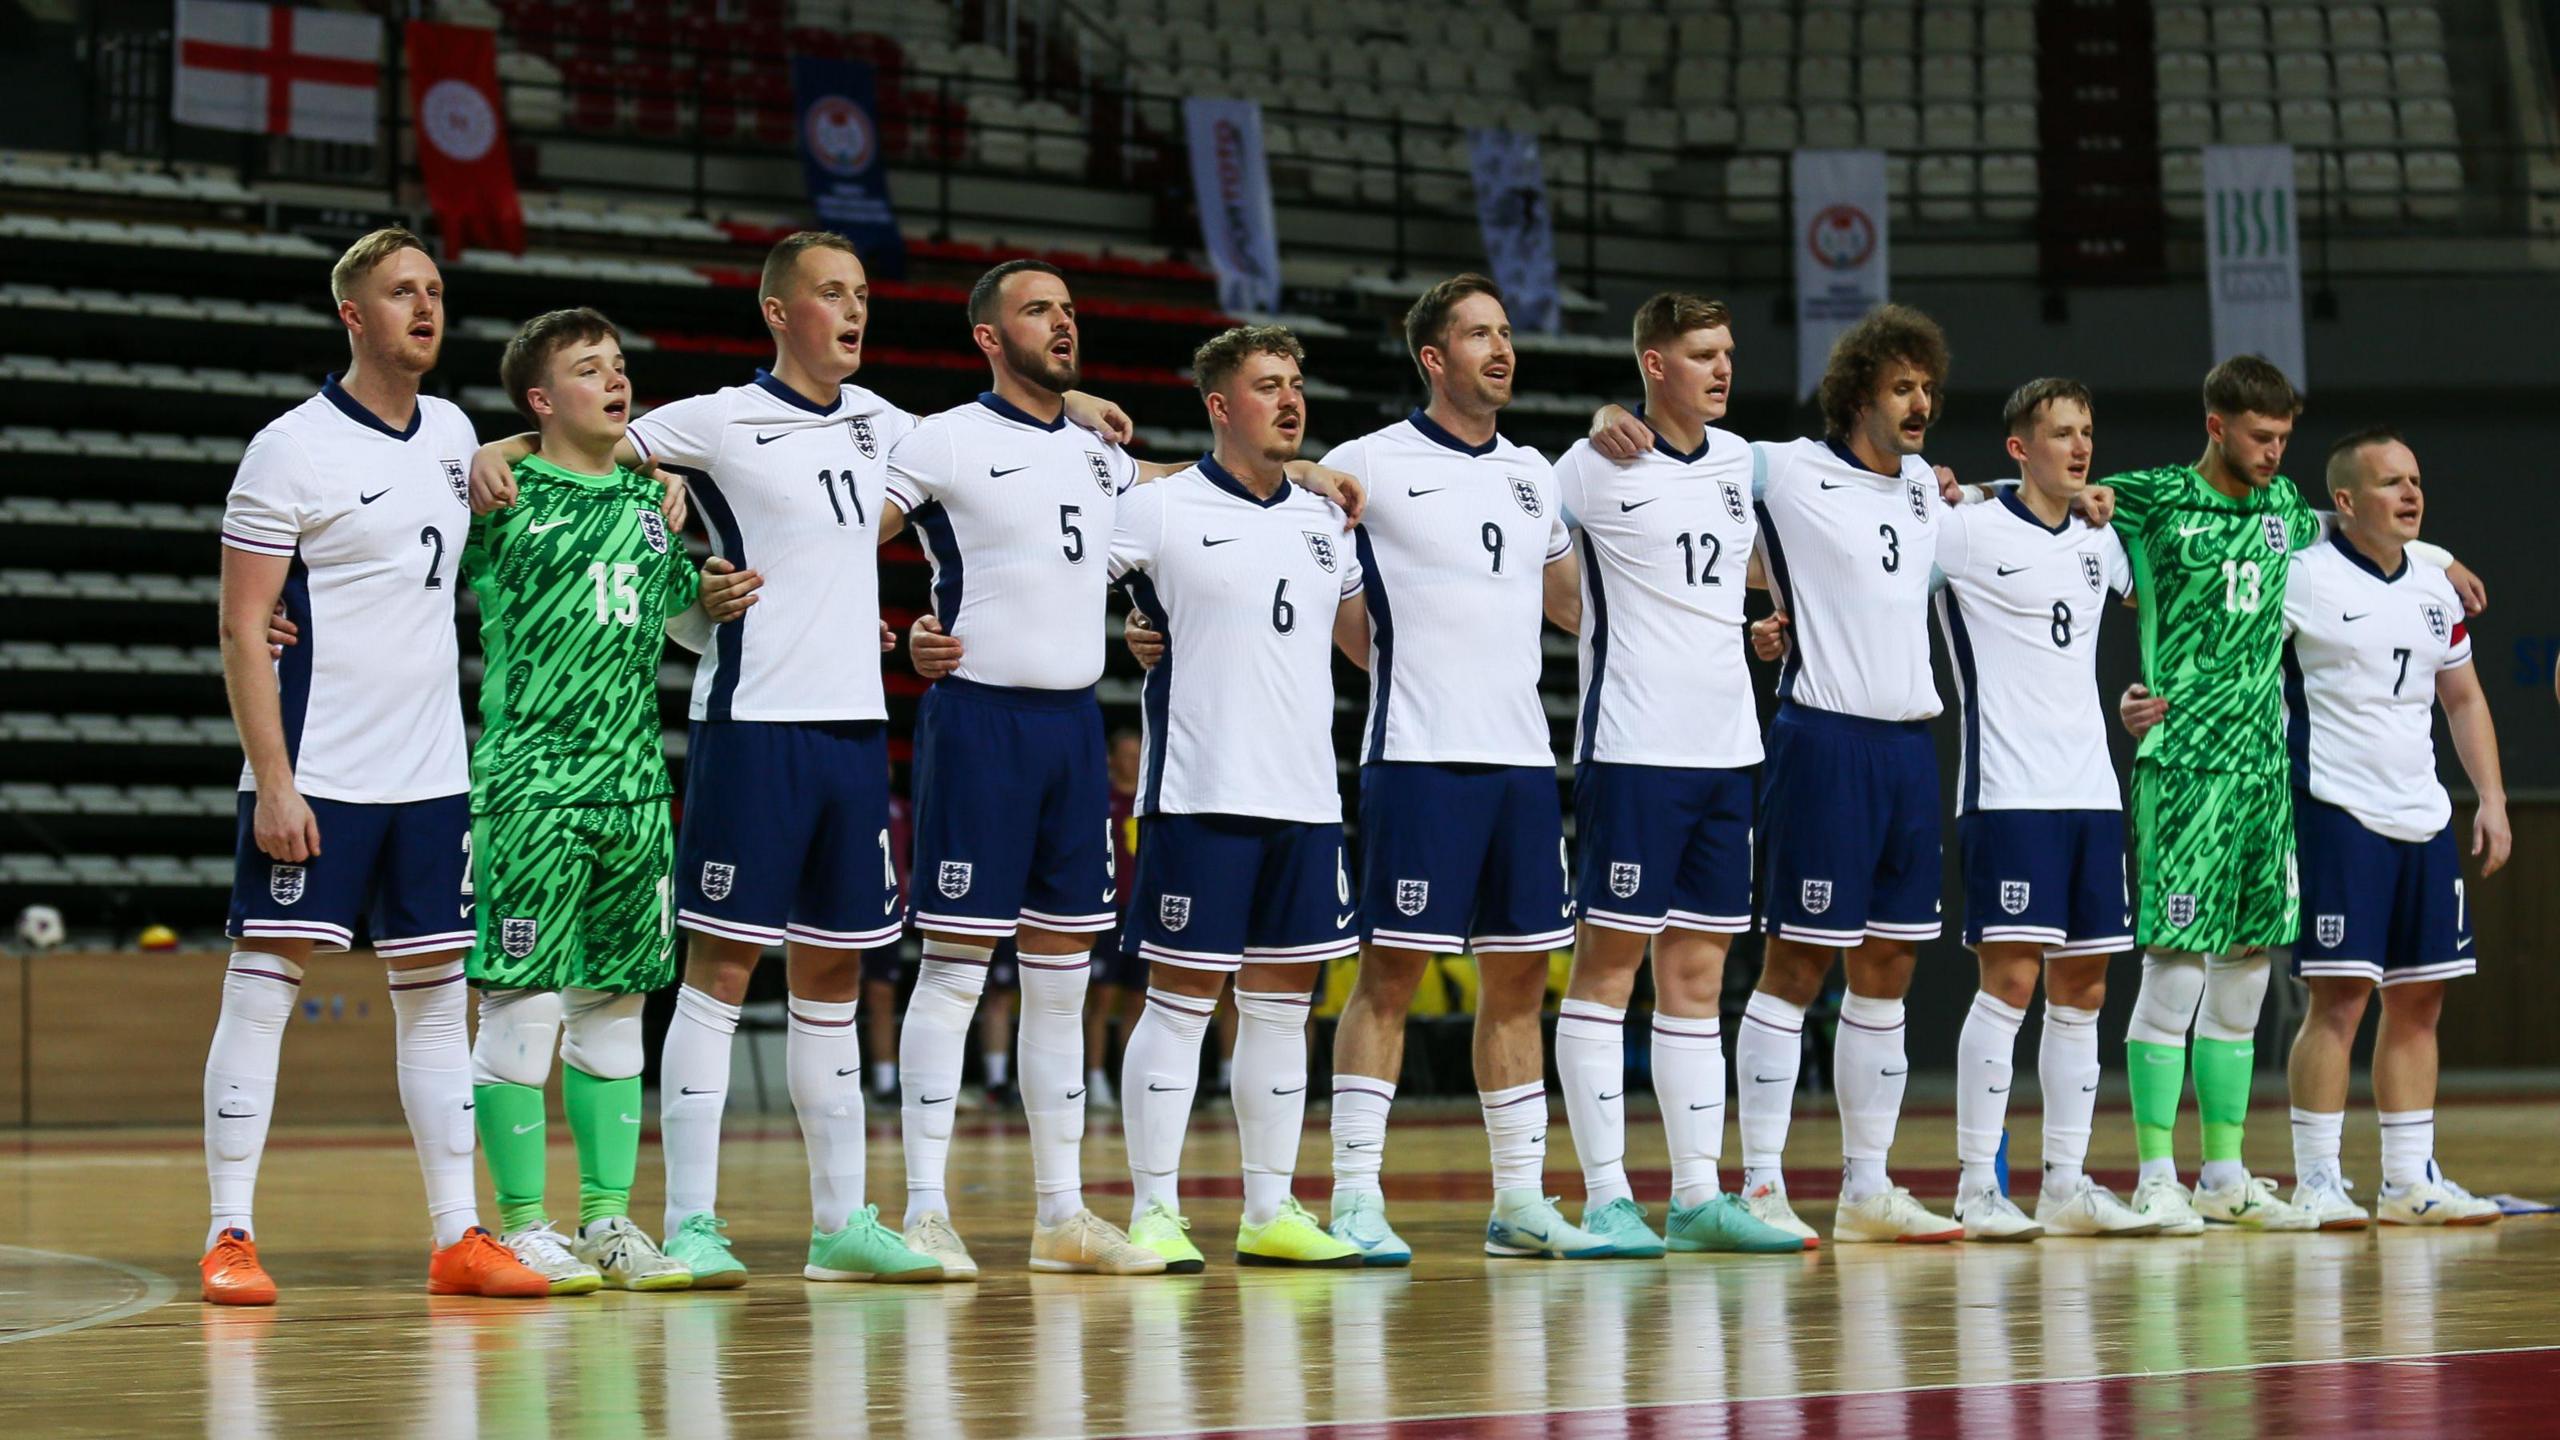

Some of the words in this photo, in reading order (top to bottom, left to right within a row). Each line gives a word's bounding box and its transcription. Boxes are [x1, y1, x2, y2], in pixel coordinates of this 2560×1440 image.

[818, 469, 864, 526] 11
[421, 526, 445, 588] 2
[1060, 504, 1083, 564] 5
[1481, 522, 1503, 575] 9
[1676, 532, 1720, 585] 12
[1879, 522, 1898, 574] 3
[588, 561, 640, 627] 15
[1272, 578, 1294, 636] 6
[2223, 559, 2260, 611] 13
[2051, 600, 2070, 648] 8
[2393, 648, 2411, 697] 7
[460, 831, 475, 894] 2
[1338, 846, 1349, 905] 6
